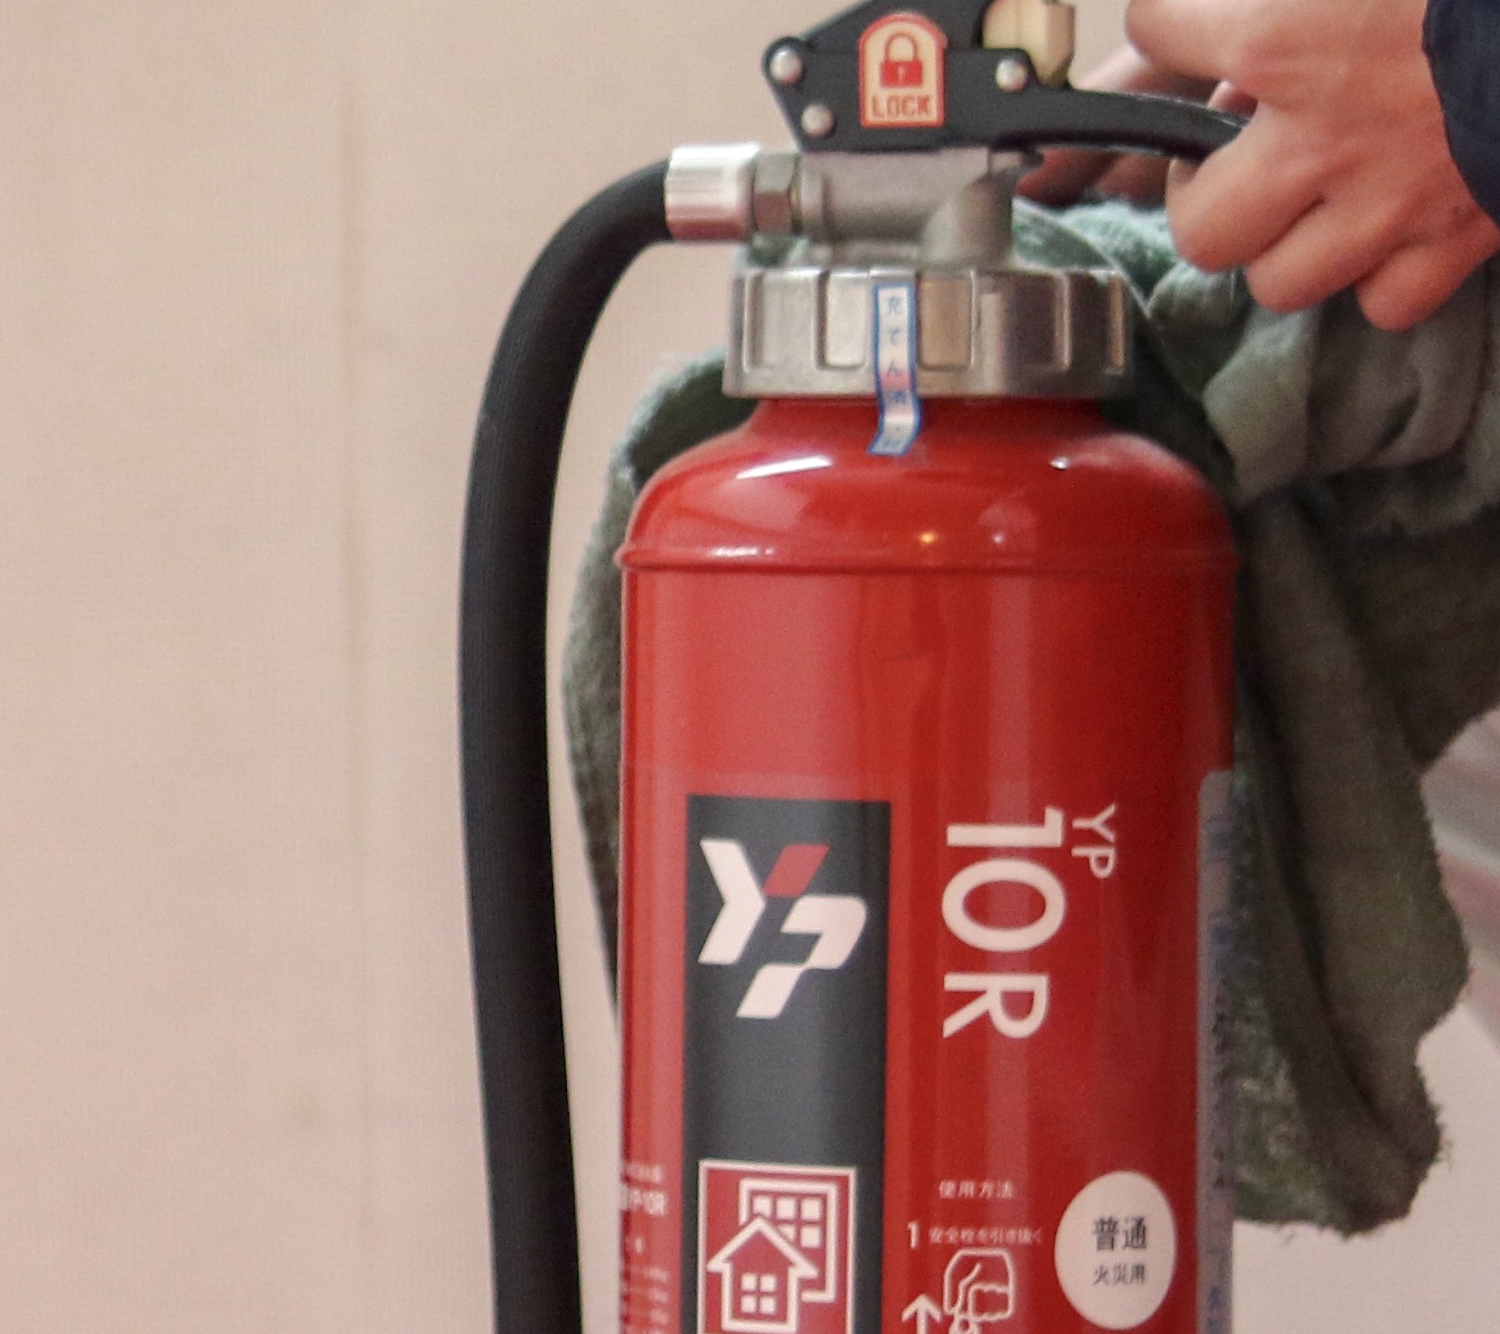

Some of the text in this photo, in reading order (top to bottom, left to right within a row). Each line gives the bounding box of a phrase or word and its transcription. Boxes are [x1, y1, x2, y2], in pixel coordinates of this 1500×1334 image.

[871, 94, 931, 119] LOCK
[1071, 804, 1116, 879] YP
[942, 807, 1066, 1039] 10R
[938, 1180, 1014, 1200] 使用方法
[907, 1221, 920, 1249] 1
[1092, 1216, 1147, 1251] 普通
[1092, 1263, 1146, 1286] 火災用
